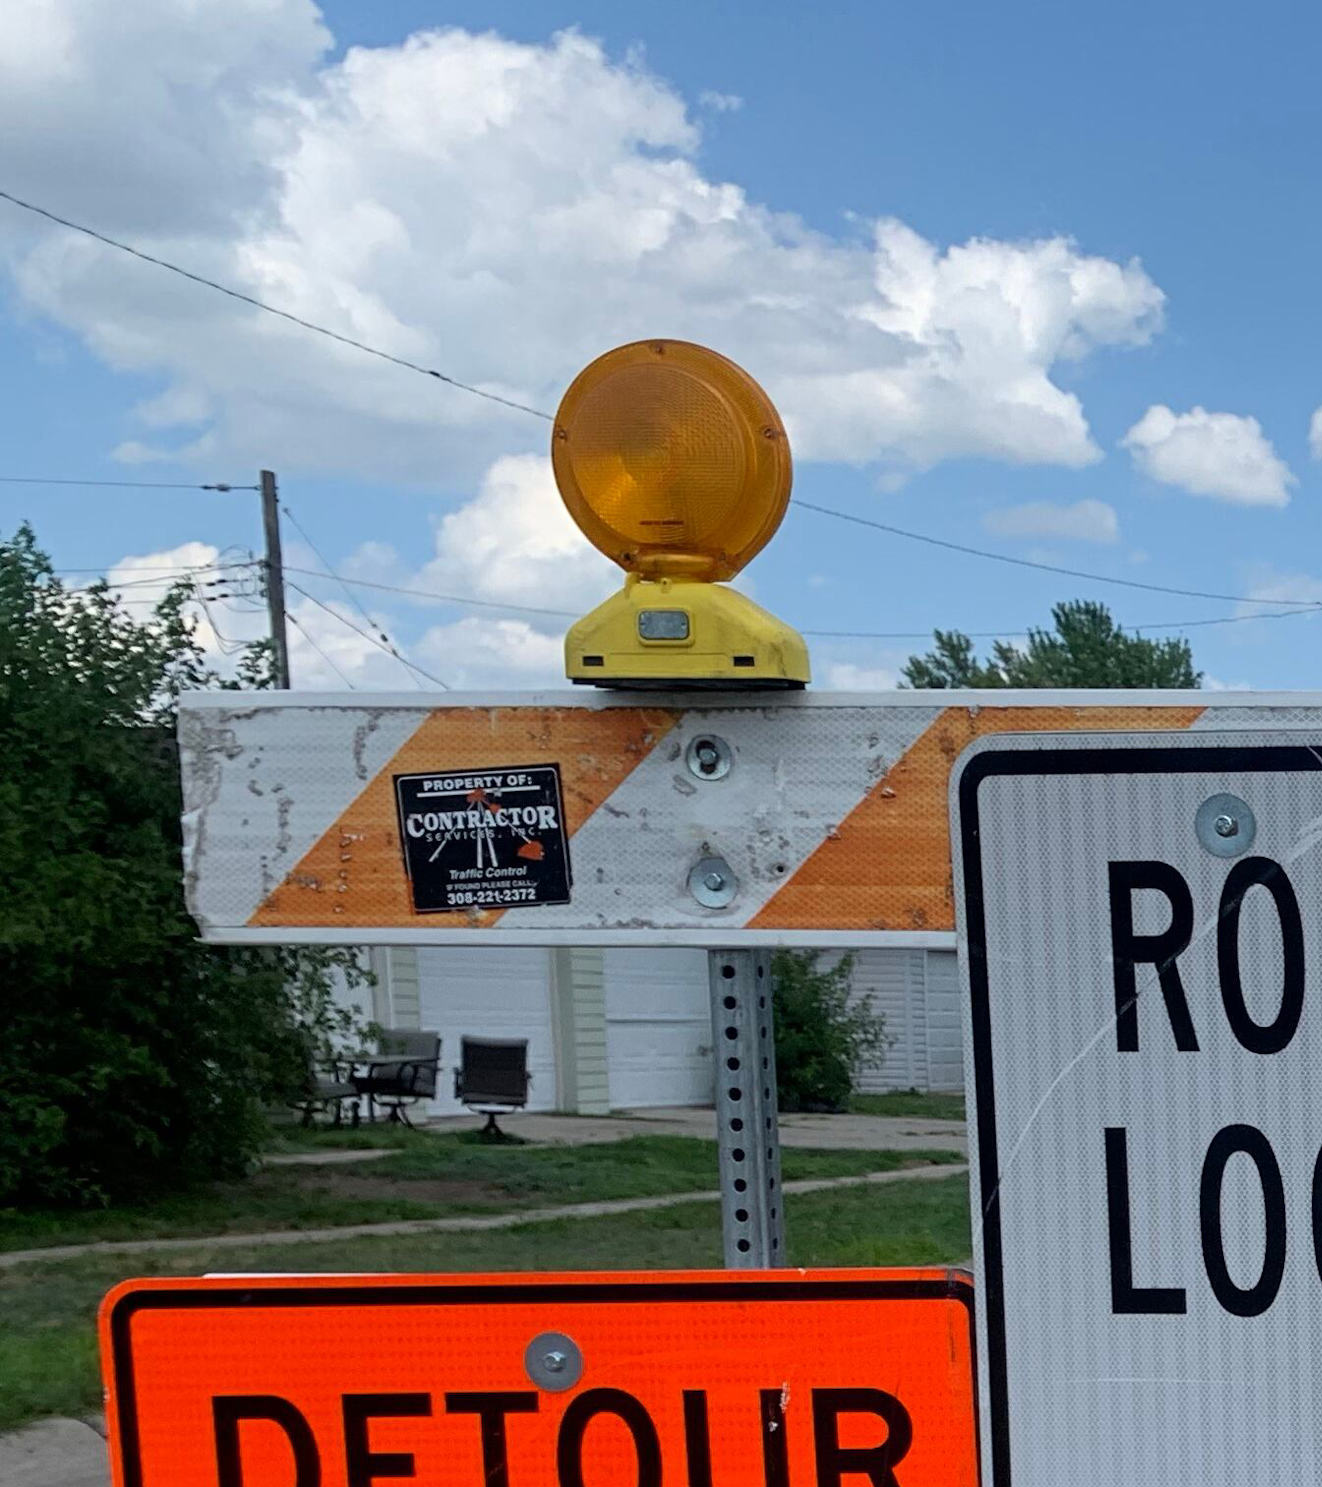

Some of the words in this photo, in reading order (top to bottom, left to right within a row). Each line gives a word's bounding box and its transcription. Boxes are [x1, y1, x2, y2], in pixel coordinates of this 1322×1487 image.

[423, 776, 503, 791] PROPERTY
[507, 775, 533, 786] OF:
[406, 805, 558, 838] CONTRACTOR
[449, 867, 483, 880] Traffic
[485, 865, 527, 878] Control
[454, 882, 480, 890] FOUND
[481, 881, 511, 889] PLEASE
[447, 888, 536, 905] 308-221-2372
